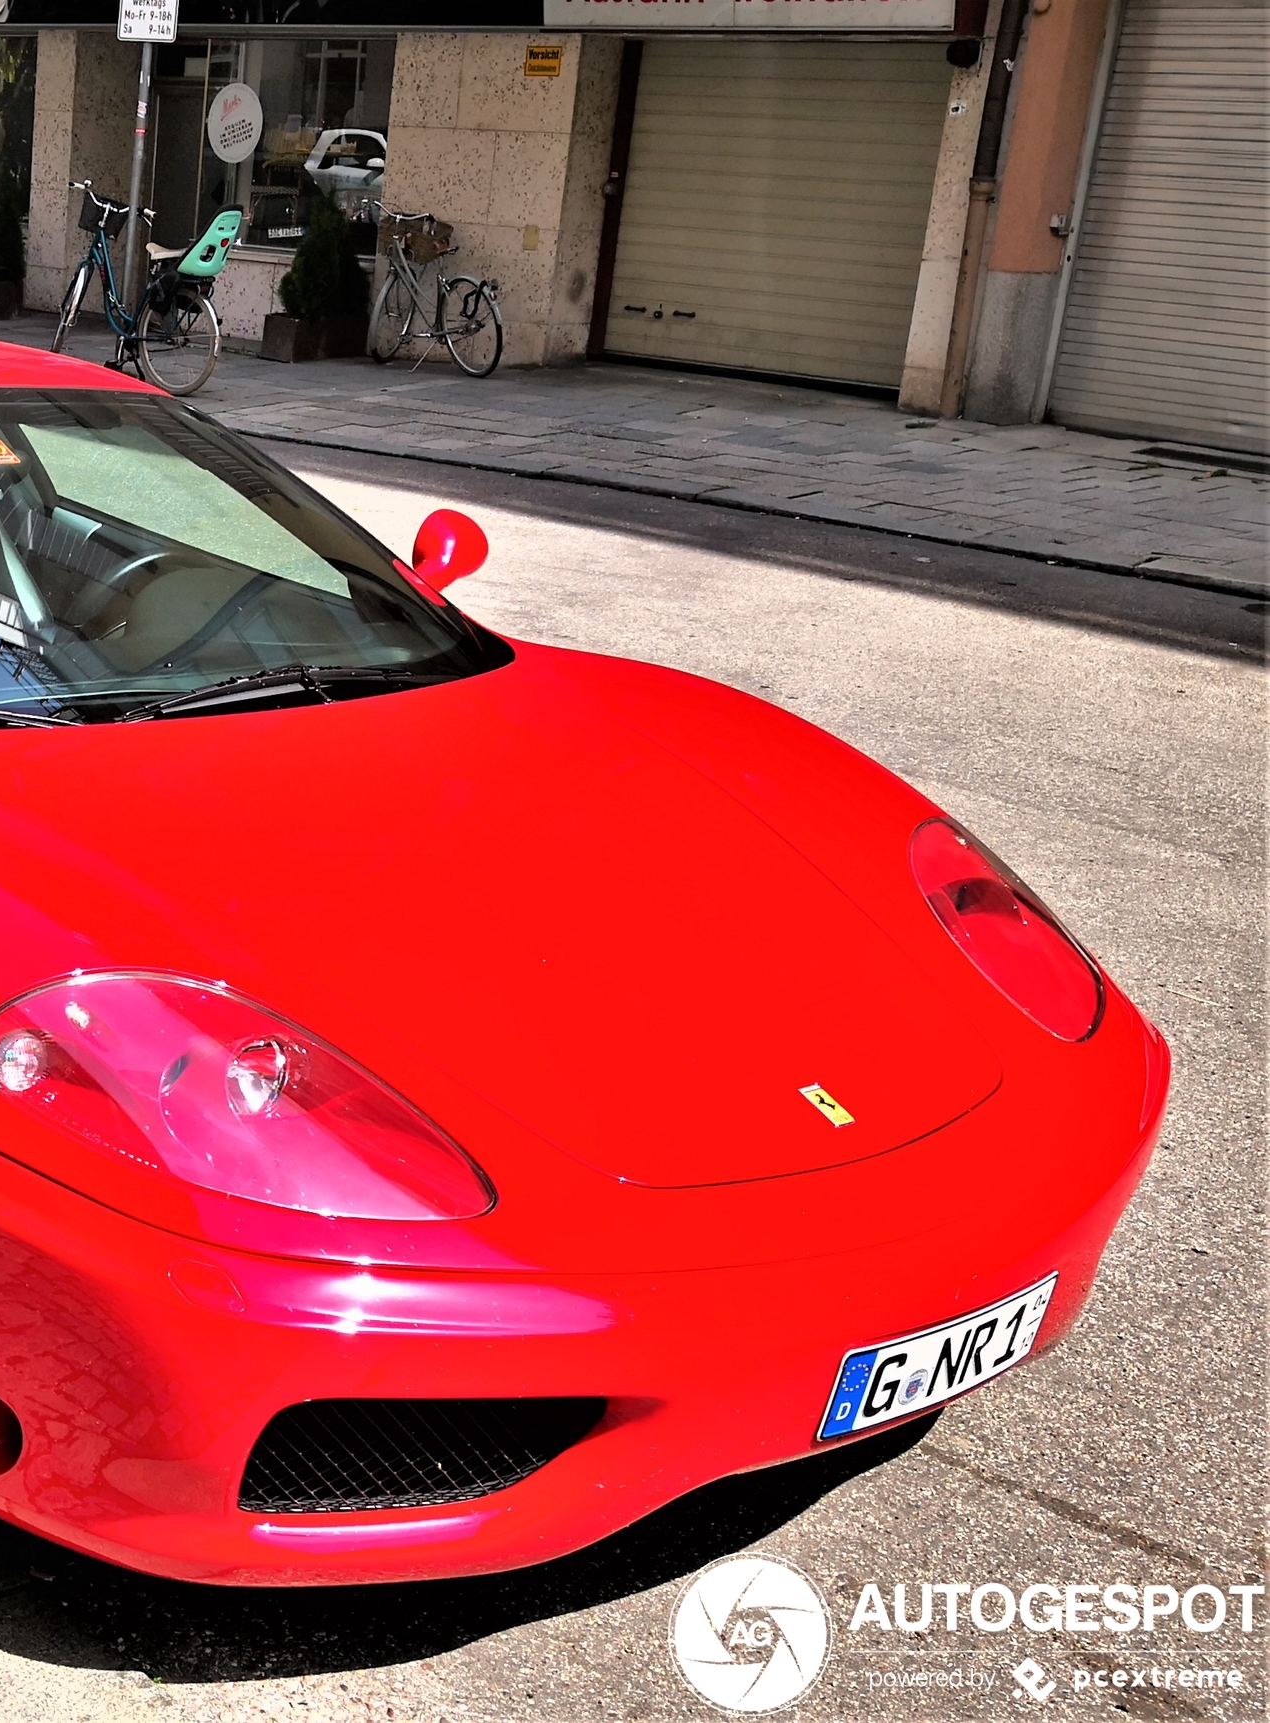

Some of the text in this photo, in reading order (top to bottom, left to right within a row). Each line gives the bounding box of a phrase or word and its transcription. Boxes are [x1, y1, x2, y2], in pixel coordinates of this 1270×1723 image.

[124, 10, 172, 21] Mo-Fr 9-18h
[123, 23, 132, 34] Sa
[528, 49, 559, 60] Vorsicht
[863, 1353, 908, 1418] G
[835, 1402, 852, 1421] D
